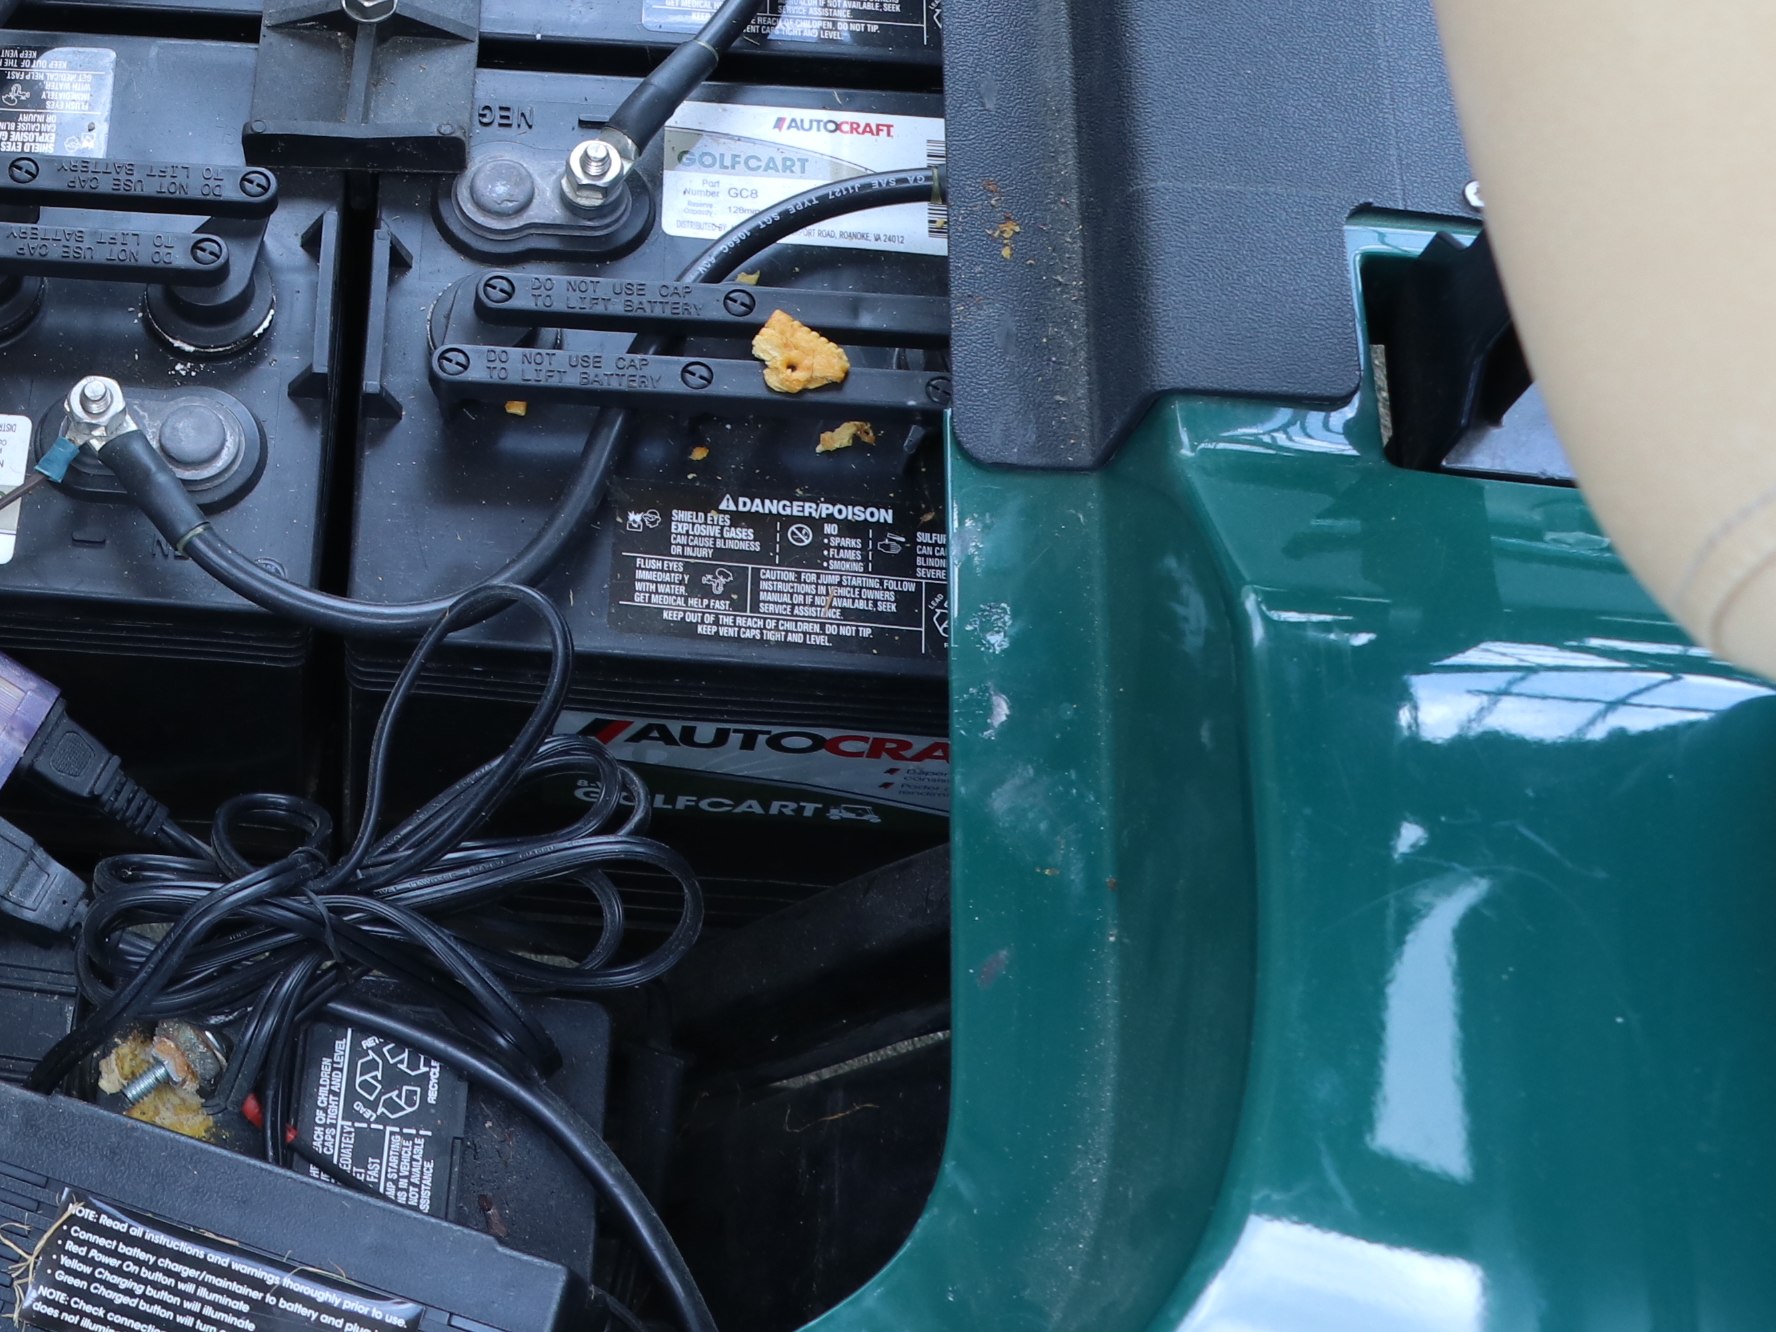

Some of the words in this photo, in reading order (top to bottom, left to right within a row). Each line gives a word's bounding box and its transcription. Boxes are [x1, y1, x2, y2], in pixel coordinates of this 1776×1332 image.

[671, 510, 705, 523] SHIELD
[706, 514, 730, 525] EYES
[737, 496, 893, 523] DANGER/POISON
[671, 522, 721, 536] EXPLOSIVE
[723, 527, 754, 539] GASES
[823, 524, 838, 535] NO
[670, 534, 687, 545] CAN
[688, 536, 714, 547] CAUSE
[715, 539, 760, 551] BLINDNESS
[670, 545, 682, 555] OR
[683, 546, 713, 557] INJURY
[829, 537, 861, 548] SPARKS
[829, 548, 861, 560] FLAMES
[636, 559, 662, 570] FLUSH
[663, 561, 683, 571] EYES
[828, 560, 863, 572] SMOKING
[634, 582, 656, 592] WITH
[656, 584, 688, 595] WATER.
[759, 570, 797, 583] CAUTION:
[800, 574, 816, 584] FOR
[817, 575, 840, 586] JUMP
[841, 577, 882, 590] STARTING,
[883, 580, 915, 592] FOLLOW
[759, 581, 816, 595] INSTRUCTIONS
[817, 585, 826, 595] IN
[861, 588, 895, 600] OWNERS
[634, 592, 649, 602] GET
[650, 594, 686, 606] MEDICAL
[687, 597, 708, 608] HELP
[709, 599, 732, 610] FAST.
[759, 592, 792, 604] MANUAL
[792, 594, 804, 605] OR
[805, 595, 812, 605] IF
[831, 597, 876, 611] AVAILABLE,
[876, 601, 897, 612] SEEK
[662, 609, 683, 620] KEEP
[684, 611, 702, 622] OUT
[703, 613, 715, 623] OF
[717, 614, 734, 625] THE
[735, 616, 764, 628] REACH
[765, 618, 776, 629] OF
[778, 619, 823, 633] CHILDREN.
[825, 624, 837, 634] DO
[838, 625, 856, 636] NOT
[857, 627, 873, 637] TIP.
[697, 624, 717, 635] KEEP
[718, 626, 738, 637] VENT
[739, 628, 761, 639] CAPS
[761, 630, 785, 641] TIGHT
[786, 632, 803, 643] AND
[805, 634, 832, 645] LEVEL.
[623, 721, 950, 762] AUTOCRA
[65, 1240, 87, 1256] Red
[88, 1248, 121, 1268] Power
[123, 1260, 139, 1274] On
[140, 1267, 175, 1288] button
[177, 1280, 195, 1295] will
[197, 1286, 249, 1312] illuminate
[70, 1226, 117, 1249] Connect
[118, 1241, 156, 1265] battery
[157, 1258, 264, 1300] charger/maintainer
[265, 1293, 276, 1305] to
[279, 1298, 318, 1322] battery
[320, 1312, 343, 1328] and
[99, 1214, 128, 1232] Read
[129, 1227, 143, 1237] all
[145, 1229, 204, 1259] instructions
[207, 1252, 229, 1267] and
[231, 1262, 281, 1286] warnings
[282, 1275, 340, 1307] thoroughly
[342, 1300, 370, 1315] prior
[371, 1308, 383, 1319] to
[385, 1314, 407, 1328] use.
[55, 1270, 87, 1289] Green
[90, 1283, 139, 1304] Charged
[139, 1303, 174, 1321] button
[176, 1309, 194, 1328] will
[60, 1254, 93, 1274] Yellow
[94, 1268, 144, 1295] Charging
[145, 1285, 181, 1306] button
[183, 1300, 201, 1316] will
[202, 1305, 255, 1331] illuminate
